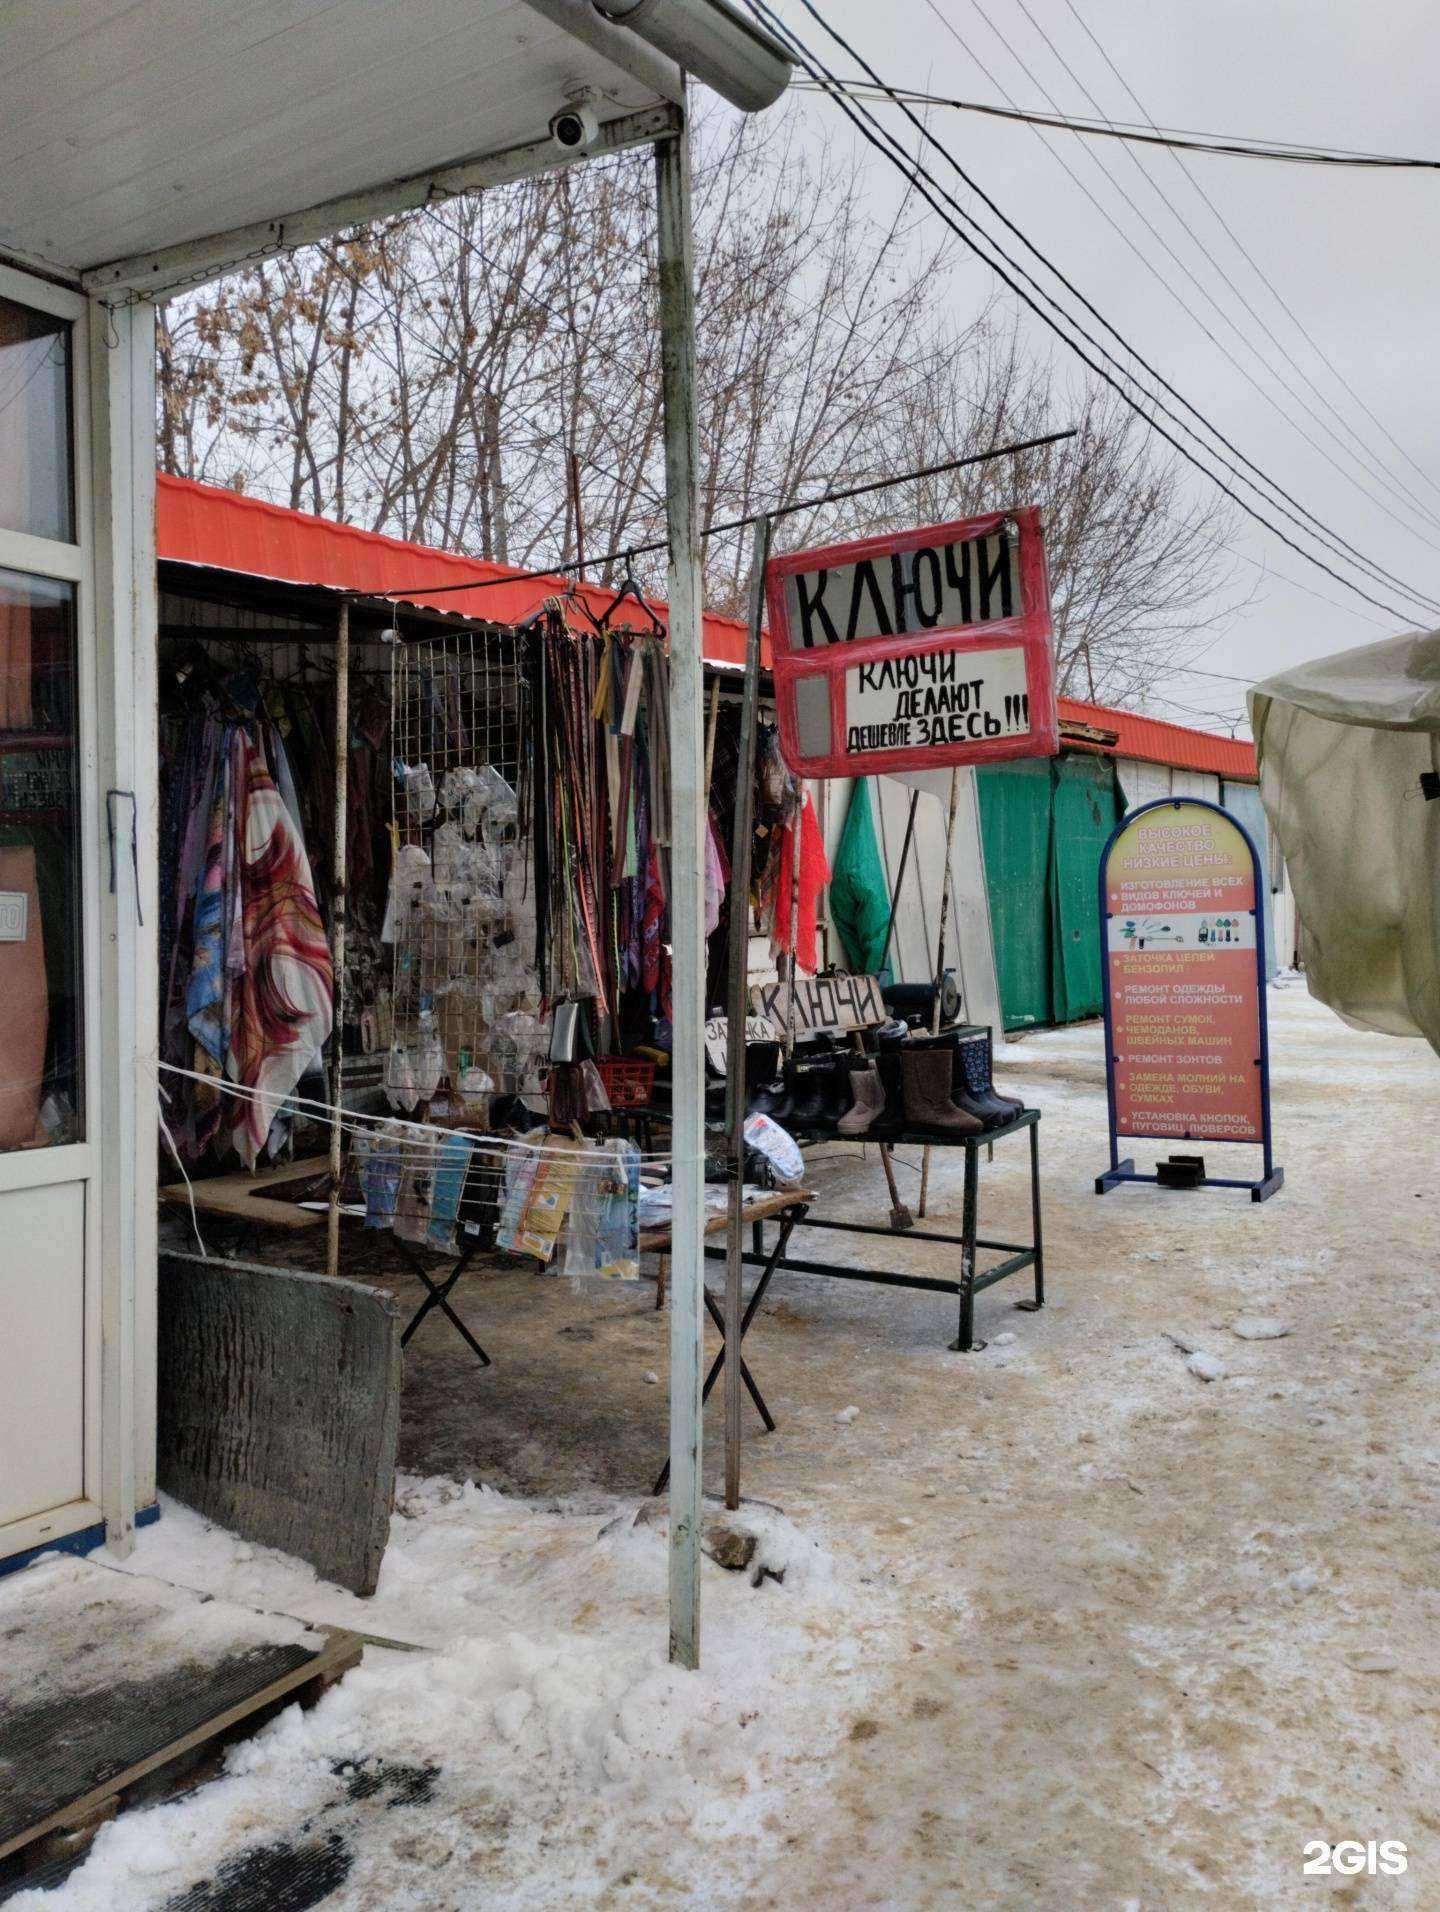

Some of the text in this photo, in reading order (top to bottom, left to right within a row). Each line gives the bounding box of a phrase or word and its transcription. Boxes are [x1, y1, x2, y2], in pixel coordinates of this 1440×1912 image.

[795, 531, 1013, 648] КЛЮЧИ
[858, 650, 956, 693] КЛЮЧИ
[893, 679, 984, 722] ДЕЛАЮТ
[846, 721, 911, 753] ДЕШЕВЛЕ
[1138, 824, 1212, 840] ВЫСОКОЕ
[1138, 840, 1215, 854] КАЧЕСТВО
[1123, 855, 1181, 869] НИЗКИЕ
[1120, 876, 1244, 890] ИЗГОТОВЛЕНИЕ ВСЕХ
[1121, 888, 1223, 902] ВИДОВ КЛЮЧЕЙ И
[1120, 901, 1196, 912] ДОМОФОНОВ
[1123, 952, 1216, 963] ЗАТОЧКА ЦЕПЕЙ
[1123, 964, 1184, 974] БЕНЗОПИЛ
[1124, 984, 1225, 994] РЕМОНТ ОДЕЖДЫ
[1124, 994, 1243, 1005] ЛЮБОЙ СЛОЖНОСТИ
[1125, 1014, 1171, 1024] РЕМОНТ
[1126, 1035, 1232, 1046] ШВЕЙНЫХ МАШИН
[1128, 1055, 1172, 1064] РЕМОНТ
[1129, 1072, 1246, 1083] ЗАМЕНА МОЛНИЙ НА
[1129, 1083, 1224, 1095] ОДЕЖДЕ, ОБУВИ,
[1129, 1094, 1174, 1103] СУМКАХ
[1131, 1111, 1250, 1124] УСТАНОВКА КНОПОК,
[1189, 1122, 1256, 1134] ЛЮВЕРСОВ
